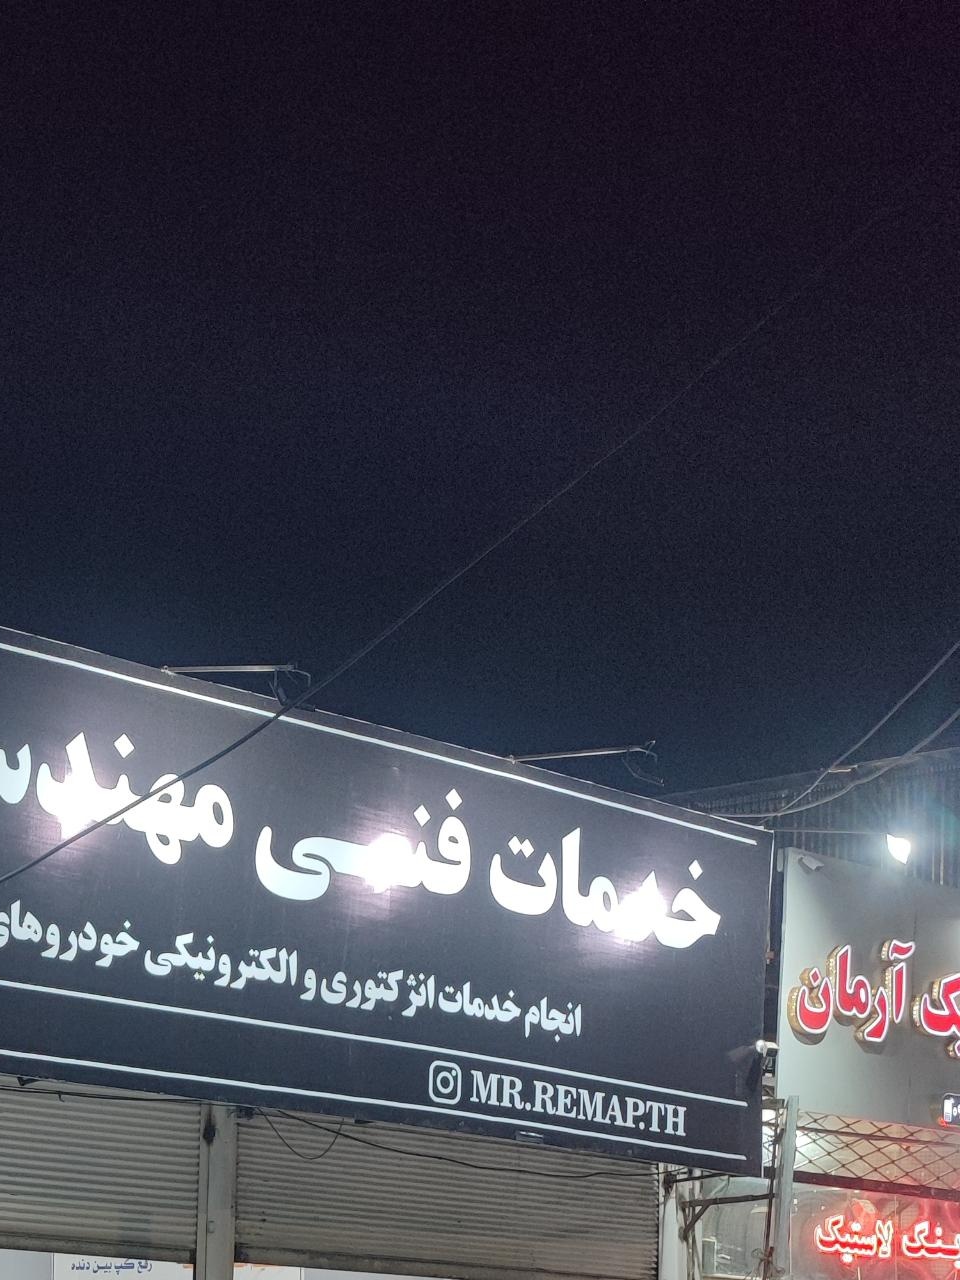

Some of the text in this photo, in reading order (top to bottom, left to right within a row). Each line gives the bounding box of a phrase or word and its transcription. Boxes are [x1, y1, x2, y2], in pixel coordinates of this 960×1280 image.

[255, 788, 471, 901] فنی
[489, 826, 722, 950] خدمات
[144, 933, 297, 989] الکترونیکی
[300, 967, 318, 1002] و
[320, 969, 437, 1018] انژکتوری
[437, 982, 522, 1023] خدمات
[797, 940, 915, 1043] آرمان
[524, 996, 583, 1043] انجام
[469, 1069, 687, 1138] MR.REMAP.TH
[814, 1215, 894, 1263] لاستیک
[93, 1261, 113, 1273] بین
